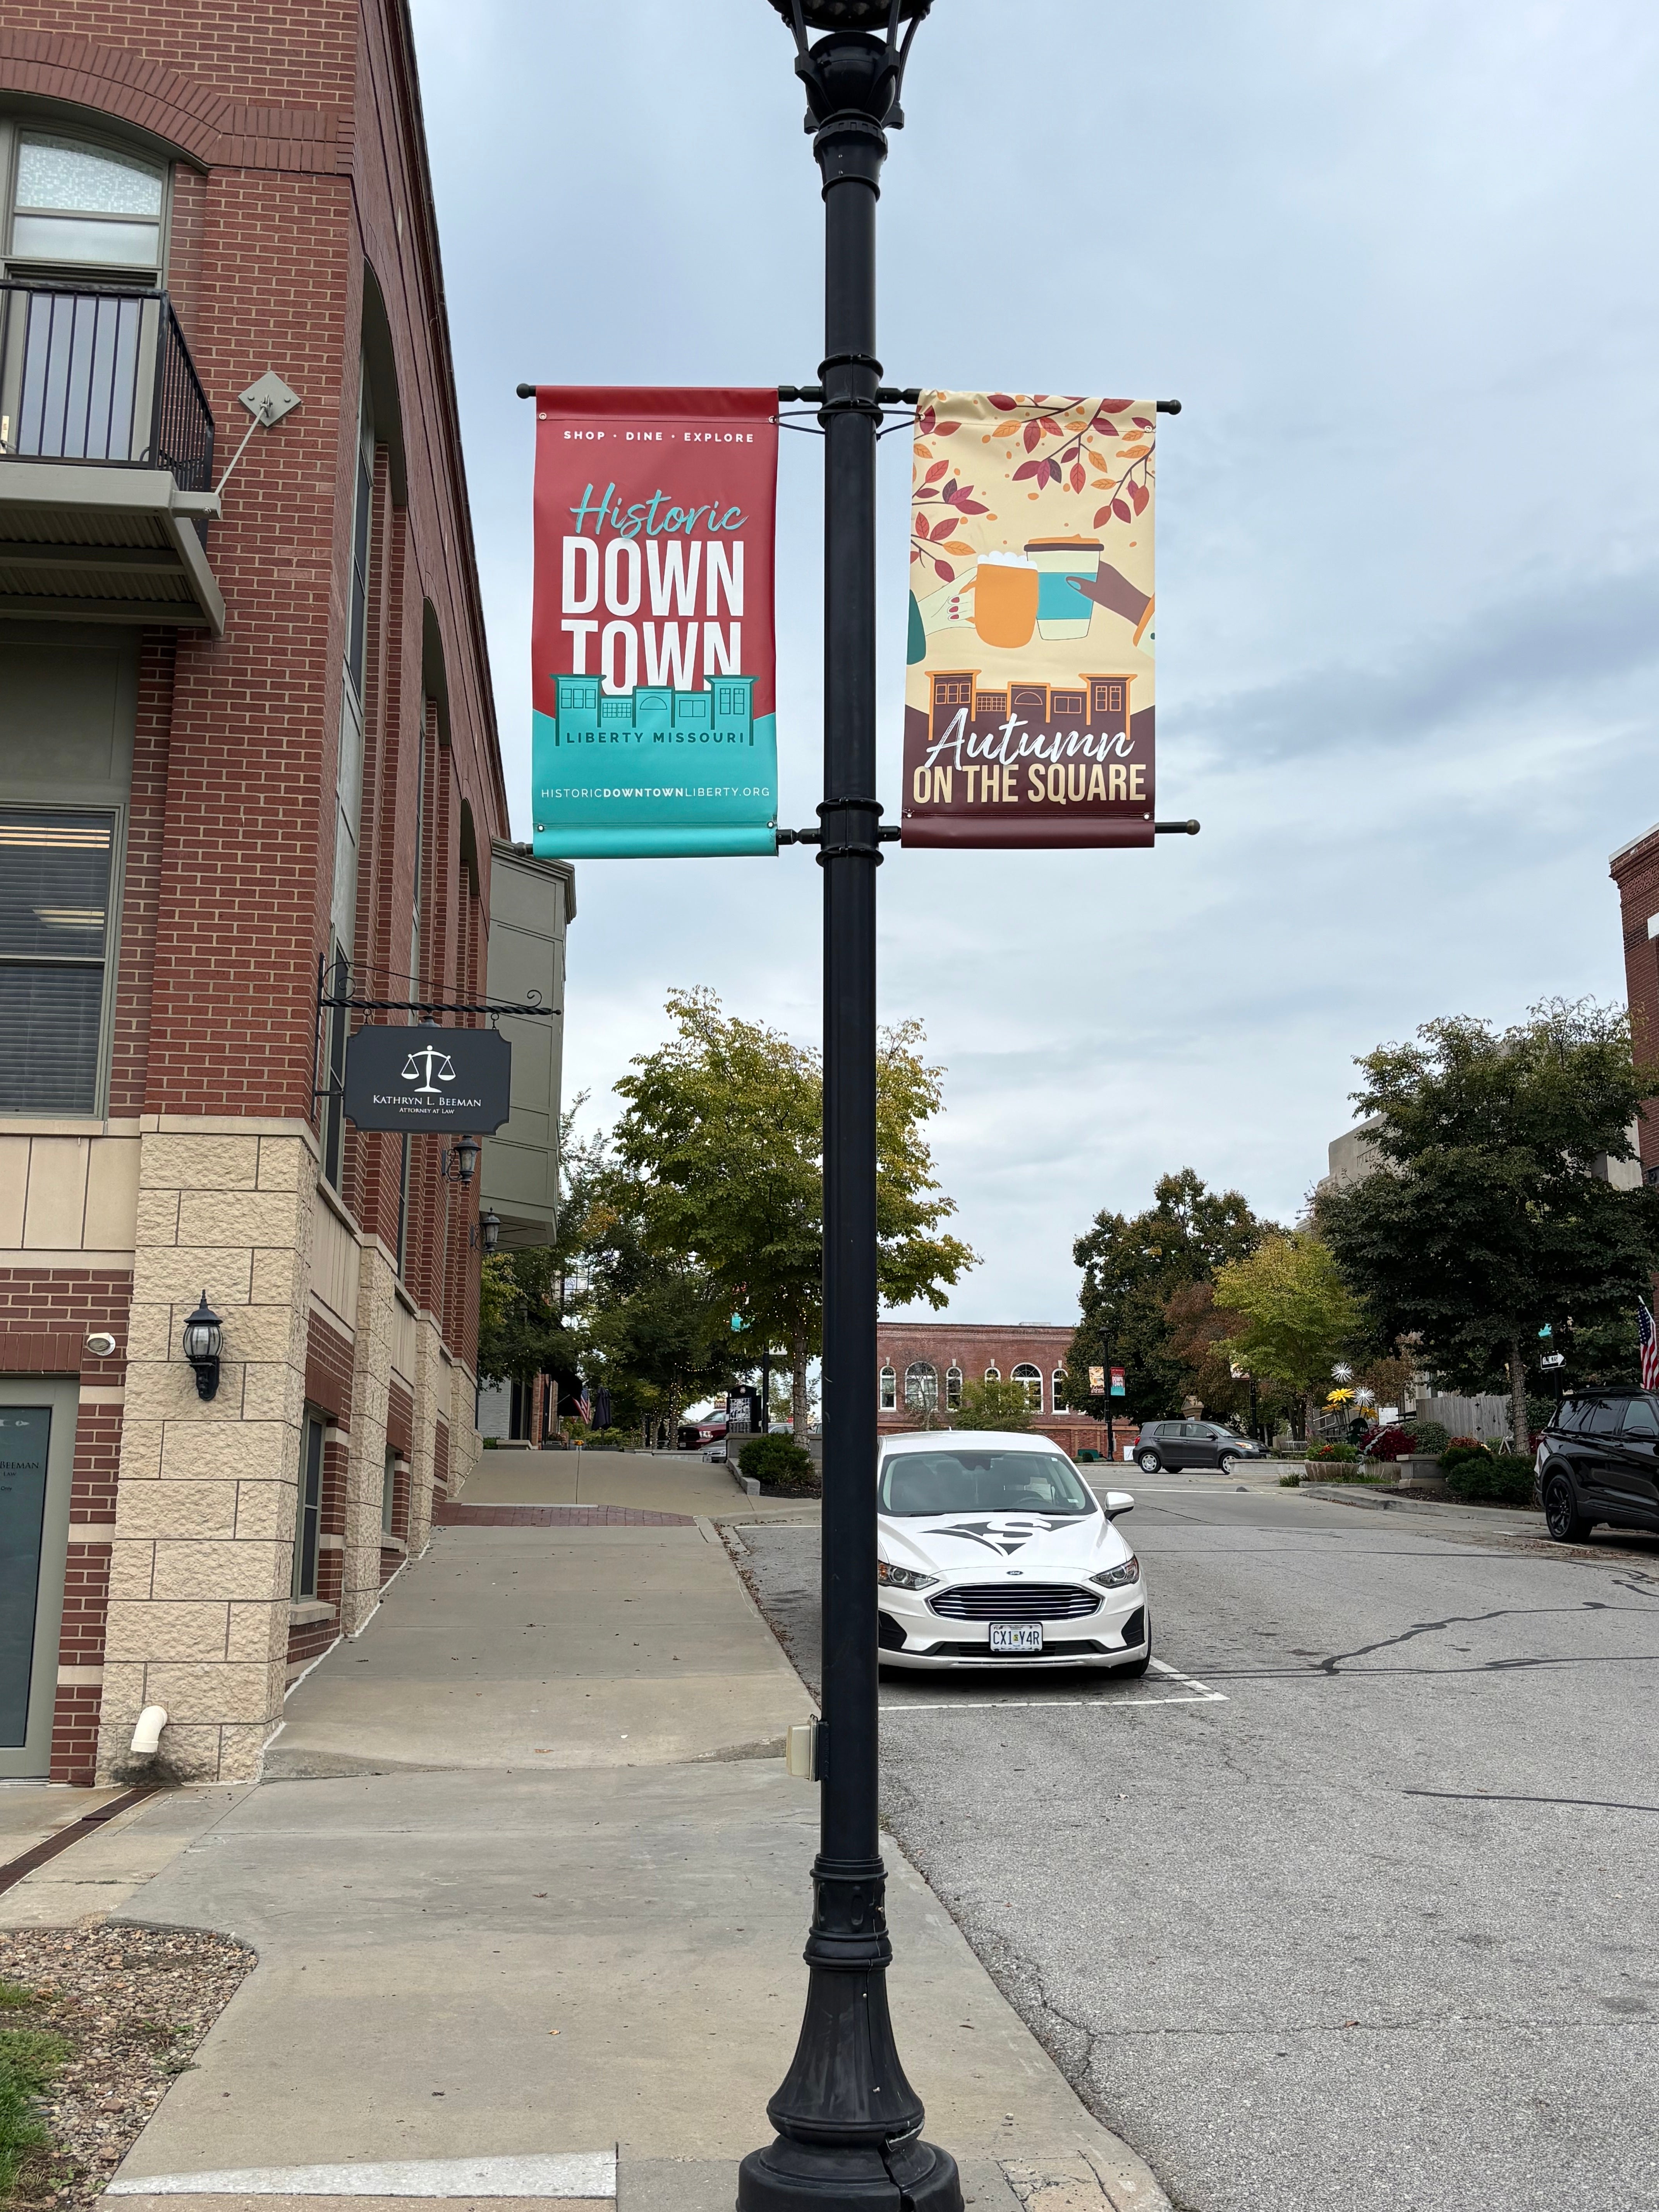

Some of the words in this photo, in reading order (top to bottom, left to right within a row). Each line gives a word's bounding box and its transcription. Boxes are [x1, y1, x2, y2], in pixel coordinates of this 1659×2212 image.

[564, 431, 605, 440] SHOP
[626, 432, 663, 441] DINE
[684, 433, 754, 443] EXPLORE
[570, 483, 749, 539] Historic
[562, 536, 744, 617] DOWN
[561, 619, 741, 696] TOWN
[567, 732, 644, 743] LIBERTY
[653, 732, 744, 743] MISSOURI
[924, 708, 1135, 771] Autumn
[541, 787, 770, 798] HISTORICDOWNTOWNLIBERTY.ORG
[913, 765, 953, 804] ON
[962, 764, 1018, 803] THE
[1027, 763, 1146, 805] SQUARE
[373, 1095, 422, 1105] KATHRYN
[428, 1096, 434, 1105] L.
[439, 1097, 481, 1107] BEEMAN
